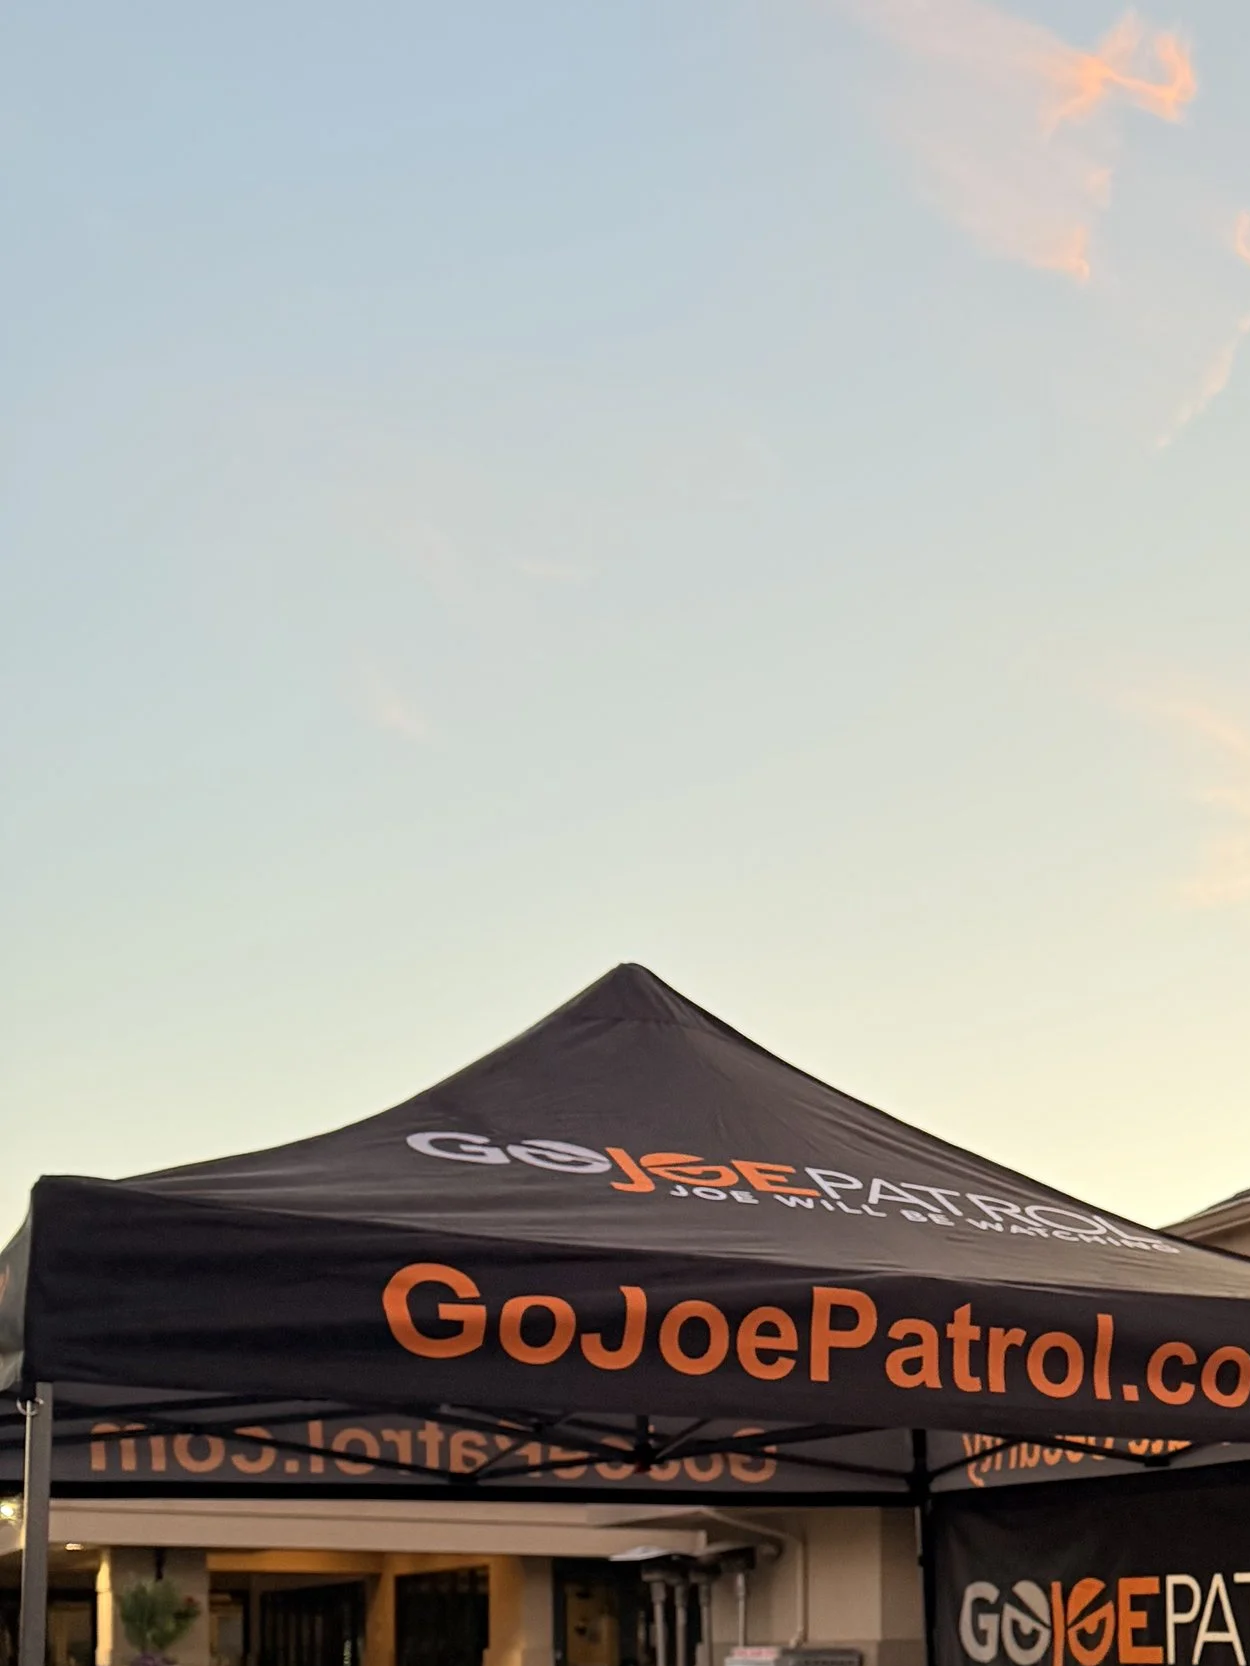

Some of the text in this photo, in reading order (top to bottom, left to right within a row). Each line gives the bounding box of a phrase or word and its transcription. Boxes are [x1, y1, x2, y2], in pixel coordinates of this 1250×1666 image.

[670, 1185, 1181, 1255] JOE WILL BE WATCHING
